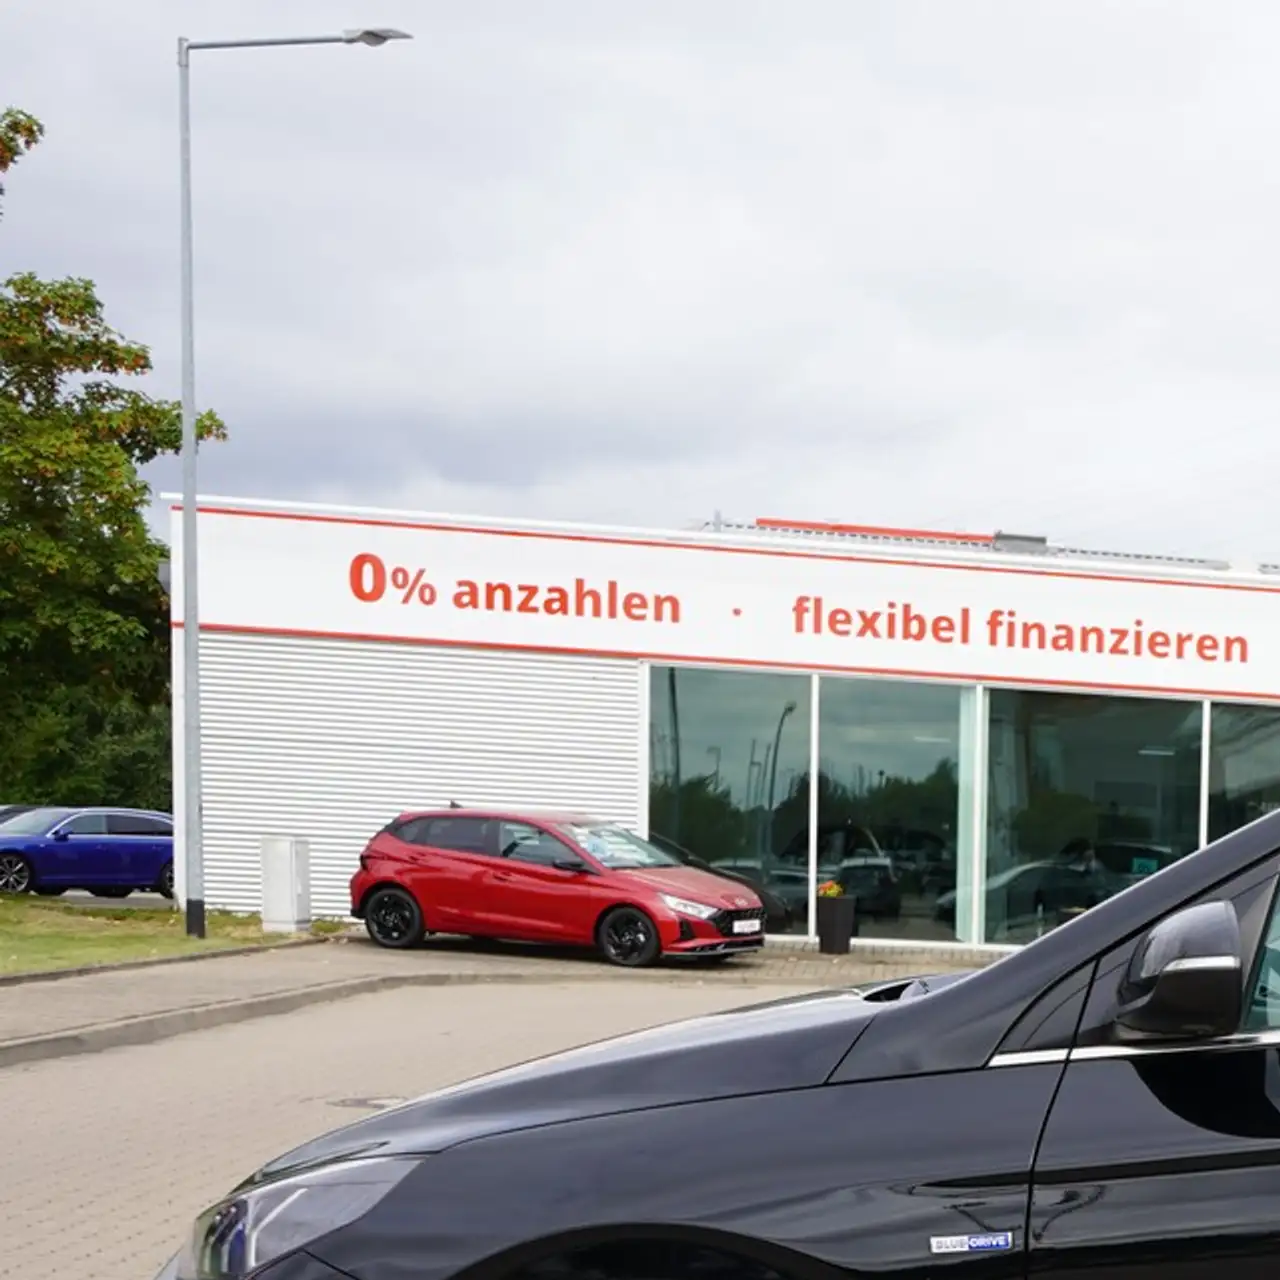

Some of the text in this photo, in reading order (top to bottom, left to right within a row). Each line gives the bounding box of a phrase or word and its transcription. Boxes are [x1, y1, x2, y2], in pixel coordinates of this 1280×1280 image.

[349, 552, 1249, 662] 0% anzahlen flexibel finanzieren
